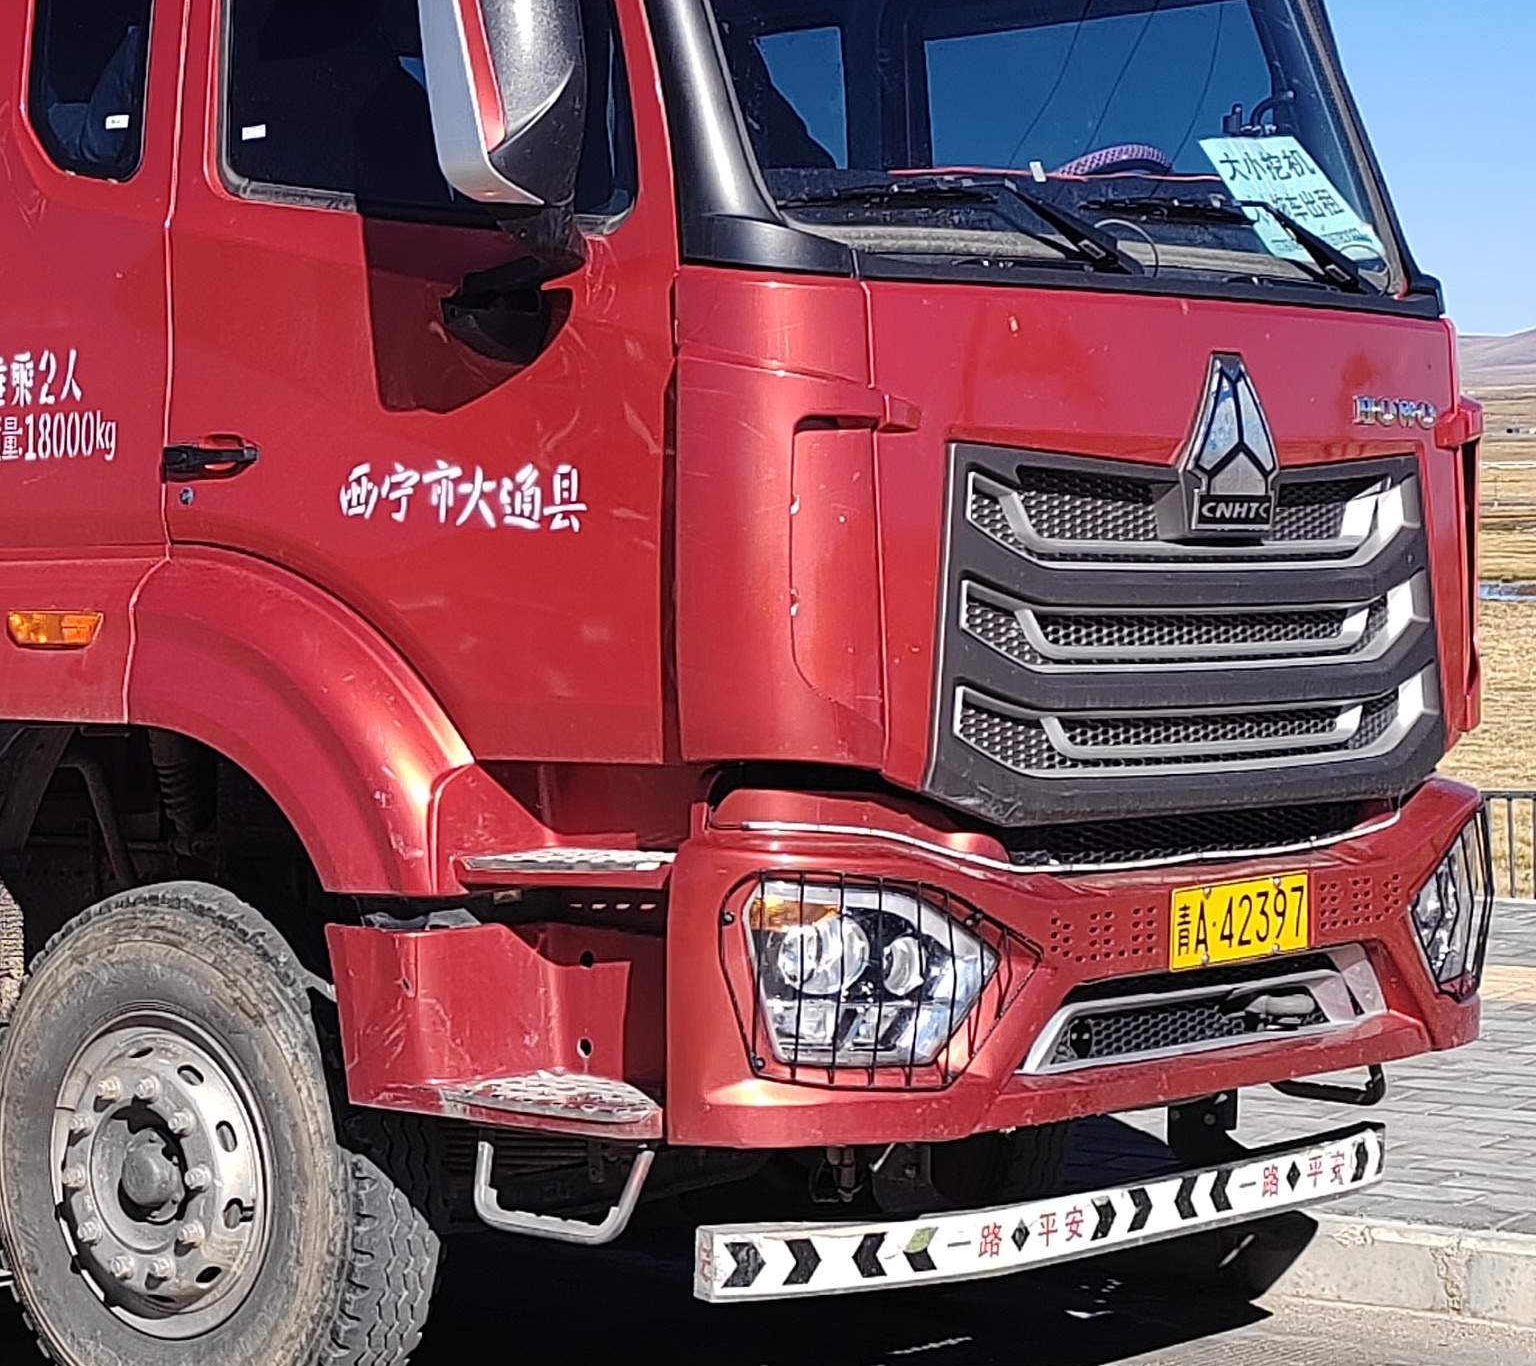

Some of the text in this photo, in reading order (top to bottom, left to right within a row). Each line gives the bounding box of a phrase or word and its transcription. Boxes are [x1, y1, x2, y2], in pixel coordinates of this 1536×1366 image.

[339, 459, 588, 533] 西宁市大通县
[1201, 502, 1269, 519] CNHTC
